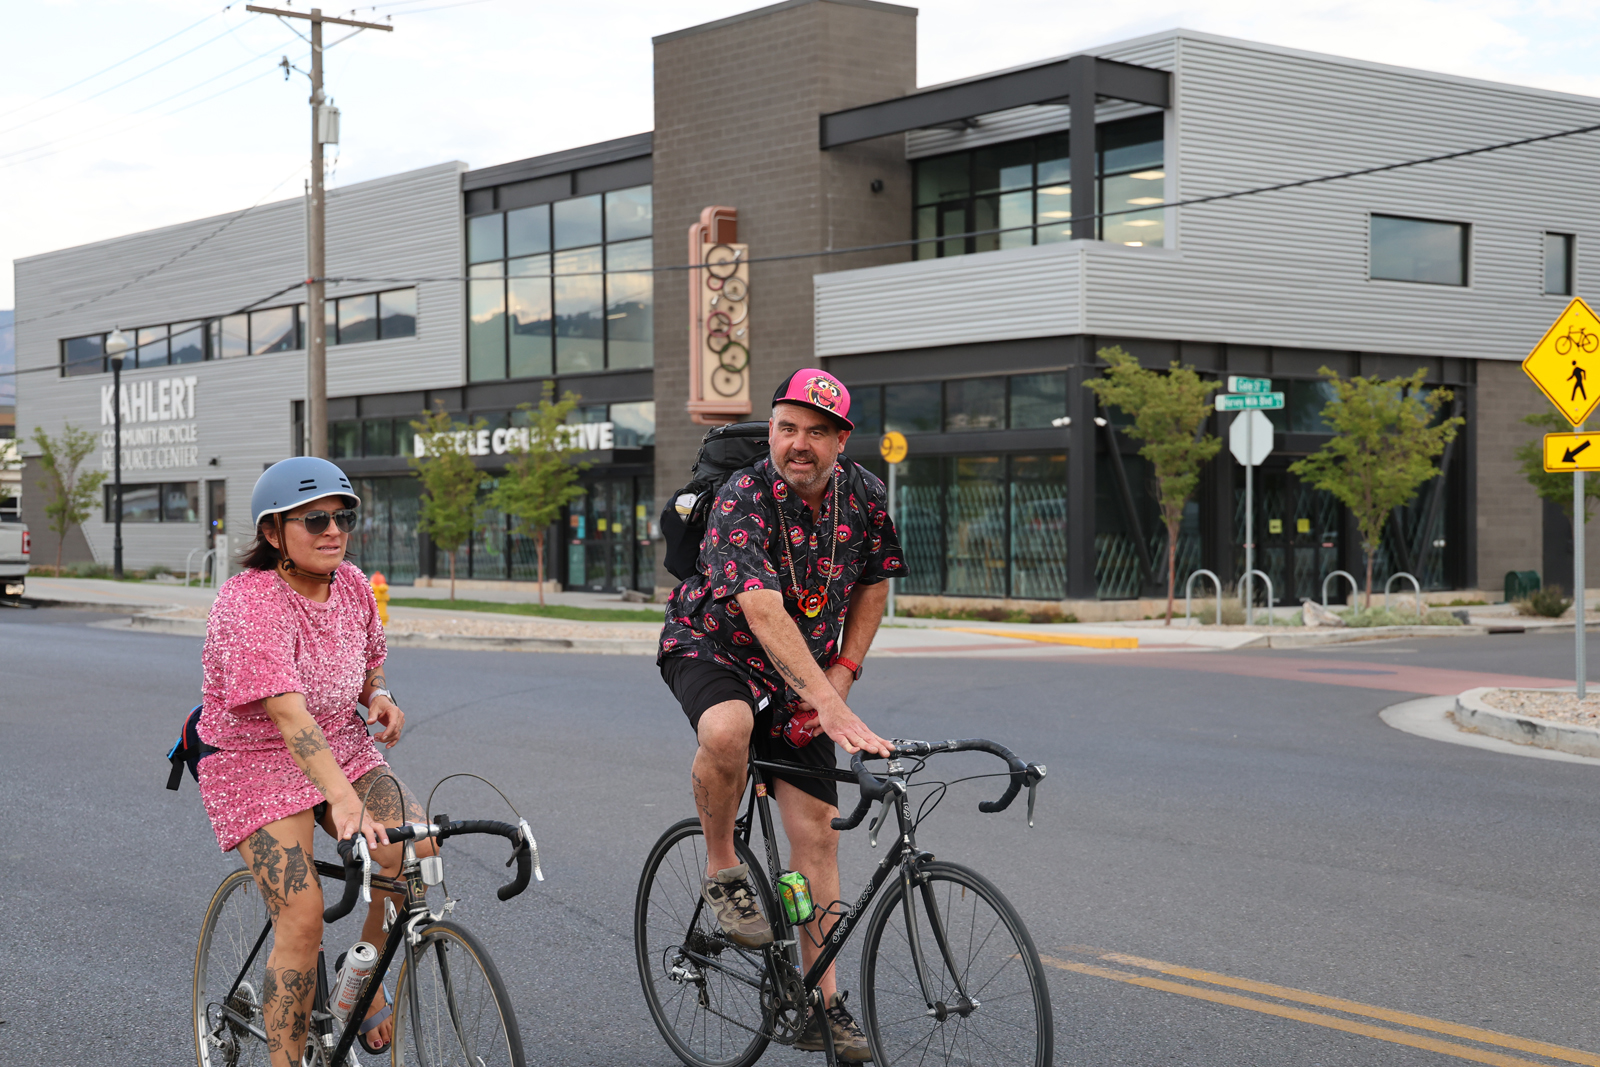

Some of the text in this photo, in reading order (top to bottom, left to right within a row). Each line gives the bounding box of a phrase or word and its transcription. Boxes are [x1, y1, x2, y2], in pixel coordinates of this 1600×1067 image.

[101, 376, 197, 425] KAHLERT
[102, 445, 198, 470] REOURCE CENTER
[414, 422, 614, 458] BCCLE COLCTIVE
